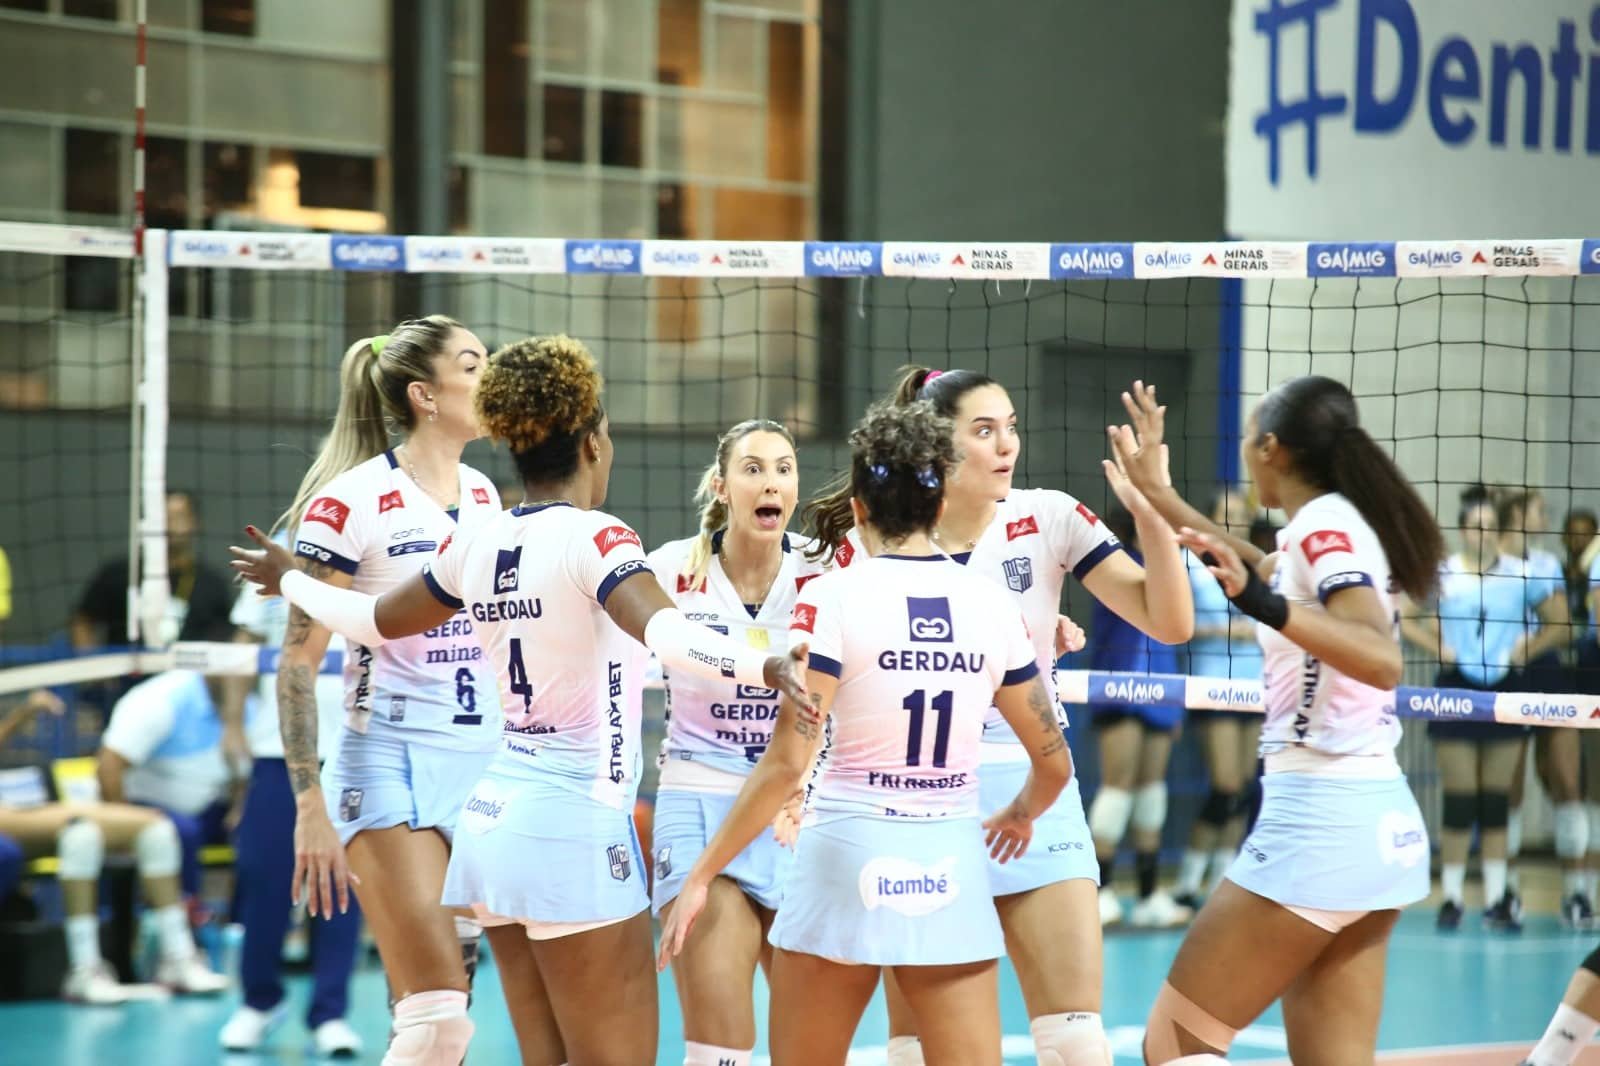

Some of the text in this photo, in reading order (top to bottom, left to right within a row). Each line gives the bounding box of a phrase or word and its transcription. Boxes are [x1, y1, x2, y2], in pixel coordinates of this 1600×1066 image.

[972, 249, 1008, 260] MINAS
[1058, 248, 1124, 273] GASMIG
[1144, 249, 1193, 267] GASMIG
[1223, 249, 1264, 260] MINAS
[1316, 247, 1387, 272] GASMIG
[1408, 249, 1463, 268] GASMIG
[1493, 245, 1533, 256] MINAS
[972, 260, 1014, 271] GERAIS
[1223, 260, 1269, 271] GERAIS
[1493, 257, 1541, 268] GERAIS
[472, 598, 542, 622] GERDAU
[424, 619, 473, 639] GERD
[426, 645, 481, 665] mina
[878, 650, 985, 674] GERDAU
[508, 638, 533, 714] 4
[455, 667, 477, 713] 6
[1105, 678, 1165, 703] GASMIG
[1208, 687, 1261, 704] GASMIG
[710, 703, 780, 721] GERDA
[1409, 693, 1473, 717] GASMIG
[1521, 702, 1577, 720] GASMIG
[902, 689, 954, 768] 11
[466, 795, 506, 819] també
[878, 874, 948, 896] itambé
